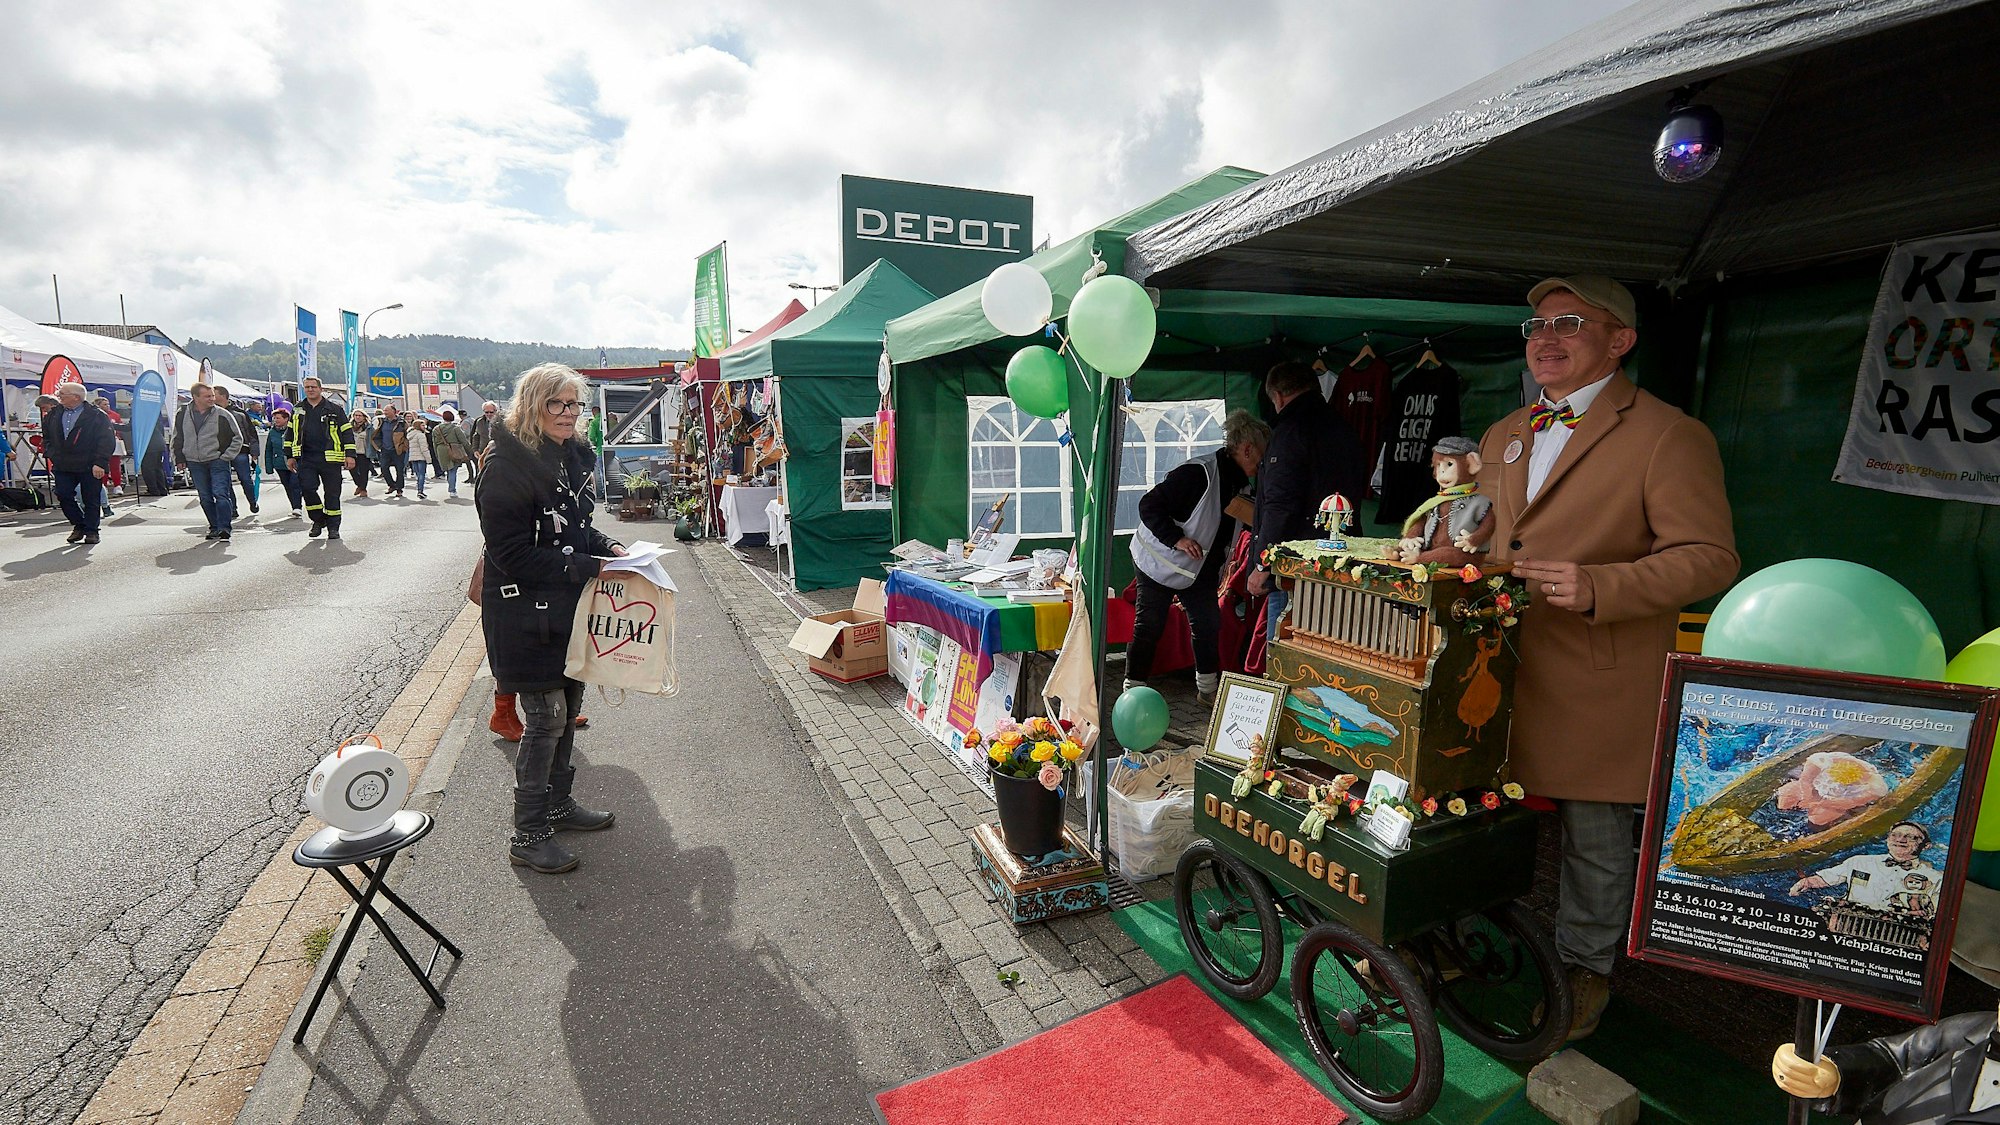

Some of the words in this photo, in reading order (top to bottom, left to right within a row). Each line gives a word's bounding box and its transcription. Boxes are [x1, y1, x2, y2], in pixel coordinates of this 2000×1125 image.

[856, 207, 1021, 248] DEPOT
[371, 376, 400, 387] TEDi
[443, 371, 453, 380] D
[601, 580, 624, 598] WIR
[1230, 701, 1244, 710] für
[1246, 705, 1264, 715] Ihre
[1234, 691, 1266, 705] Danke
[1685, 691, 1715, 705] Die
[1719, 693, 1780, 715] Kunst,
[1785, 703, 1827, 719] nicht
[1228, 711, 1263, 726] Spende
[1683, 706, 1707, 716] Nach
[1711, 709, 1729, 719] der
[1730, 711, 1750, 721] Flut
[1753, 714, 1765, 723] ist
[1767, 716, 1788, 726] Zeit
[1790, 718, 1806, 727] für
[1808, 720, 1830, 730] Mut
[1204, 792, 1368, 905] DREHORGEL
[1658, 874, 1710, 891] Bürgermeister
[1710, 883, 1734, 895] Sacha
[1734, 887, 1766, 900] Reichelt
[1659, 867, 1703, 881] Schirmherr:
[1656, 889, 1670, 899] 15
[1671, 892, 1683, 902] &
[1686, 895, 1734, 912] 16.10.22
[1749, 906, 1764, 918] 10
[1777, 912, 1791, 923] 18
[1794, 915, 1819, 928] Uhr
[1654, 899, 1717, 920] Euskirchen
[1731, 915, 1816, 939] Kapellenstr.29
[1832, 934, 1923, 961] Viehplätzchen
[1650, 931, 1662, 939] der
[1661, 933, 1694, 946] Künstlerin
[1694, 940, 1718, 951] MARA
[1718, 944, 1732, 954] und
[1732, 948, 1781, 964] DREHORGEL
[1781, 958, 1811, 970] SIMON.
[1651, 925, 1670, 934] Leben
[1671, 927, 1678, 936] in
[1678, 929, 1716, 943] Euskirchens
[1716, 938, 1744, 950] Zentrum
[1744, 943, 1752, 951] in
[1752, 946, 1770, 955] einer
[1769, 950, 1808, 963] Ausstellung
[1808, 956, 1816, 964] in
[1834, 961, 1850, 971] Text
[1850, 965, 1865, 975] und
[1865, 968, 1880, 978] Ton
[1881, 971, 1894, 981] mit
[1895, 974, 1922, 986] Werken
[1652, 918, 1668, 927] Zwei
[1668, 920, 1685, 931] Jahre
[1685, 922, 1693, 932] in
[1693, 926, 1736, 941] künstlerischer
[1736, 936, 1801, 954] Auseinandersetzung
[1801, 949, 1813, 957] mit
[1868, 962, 1889, 974] Krieg
[1889, 967, 1904, 976] und
[1904, 970, 1921, 979] dem
